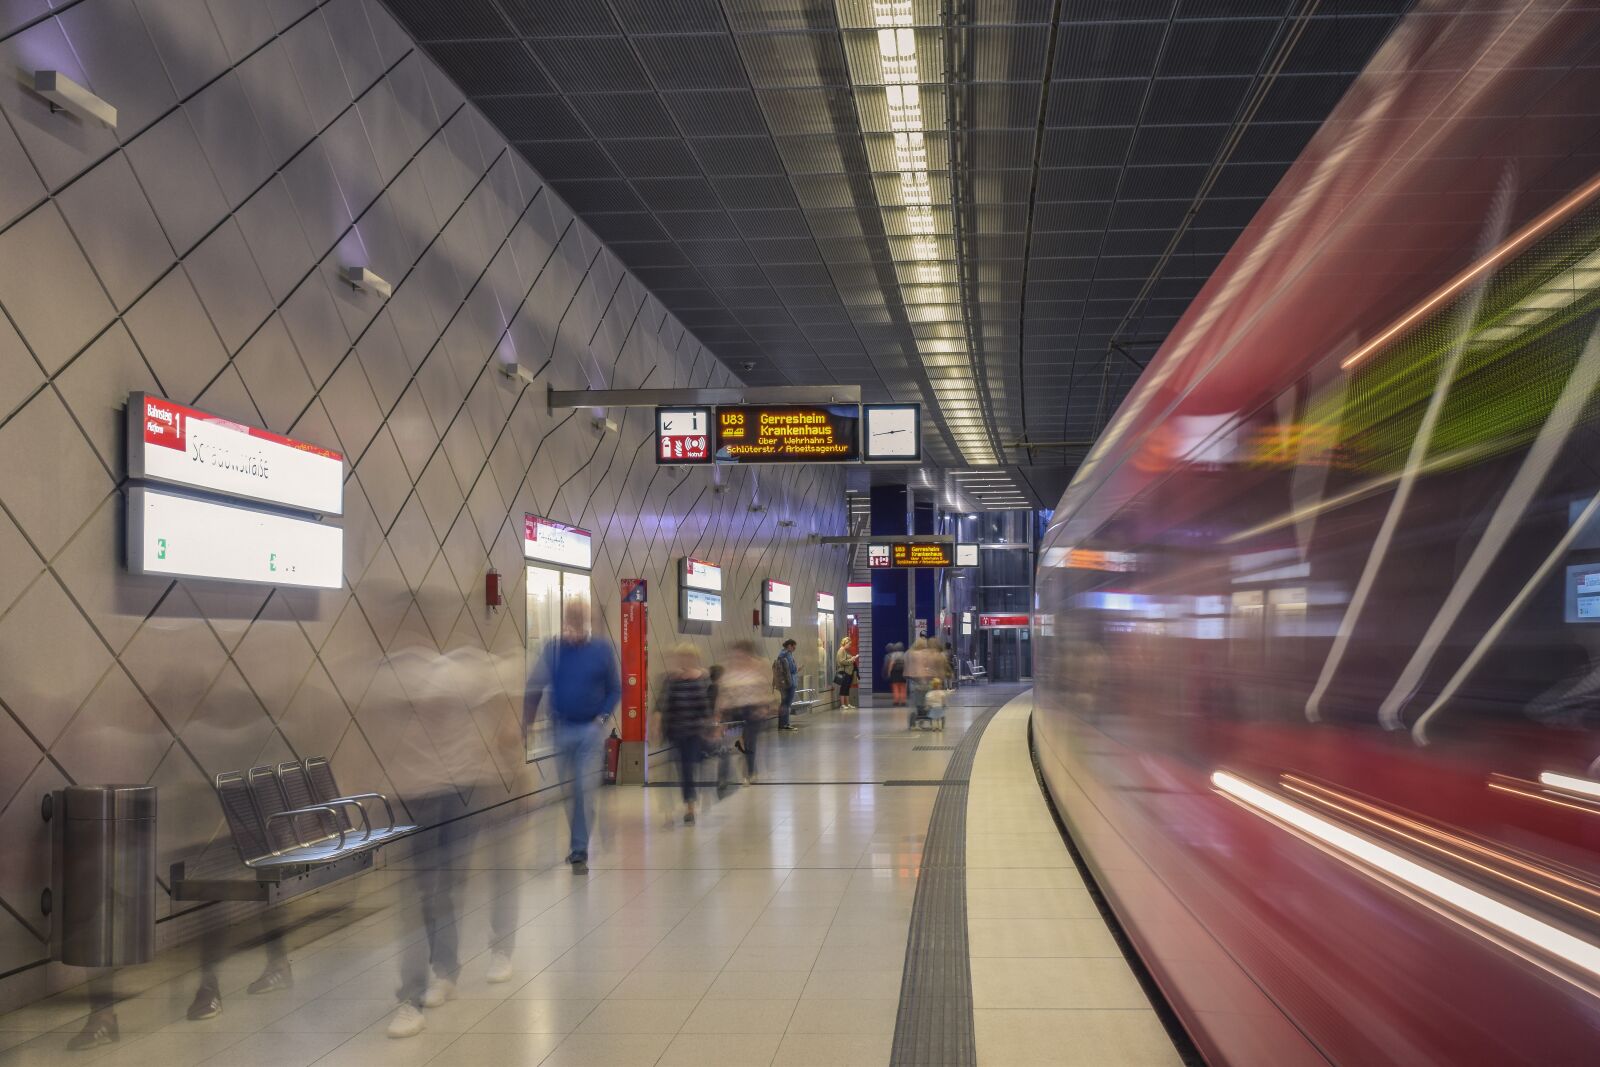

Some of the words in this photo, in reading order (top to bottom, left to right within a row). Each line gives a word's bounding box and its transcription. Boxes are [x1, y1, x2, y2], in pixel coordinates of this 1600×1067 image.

[148, 404, 172, 426] Bahnsteig
[175, 412, 180, 439] 1
[722, 414, 744, 426] U83
[760, 413, 825, 425] Gerresheim
[760, 425, 832, 436] Krankenhaus
[757, 436, 778, 445] über
[784, 436, 825, 445] Wehrhahn
[826, 436, 833, 444] S
[727, 445, 775, 454] Schlüterstr.
[785, 445, 848, 454] Arbeitsagentur
